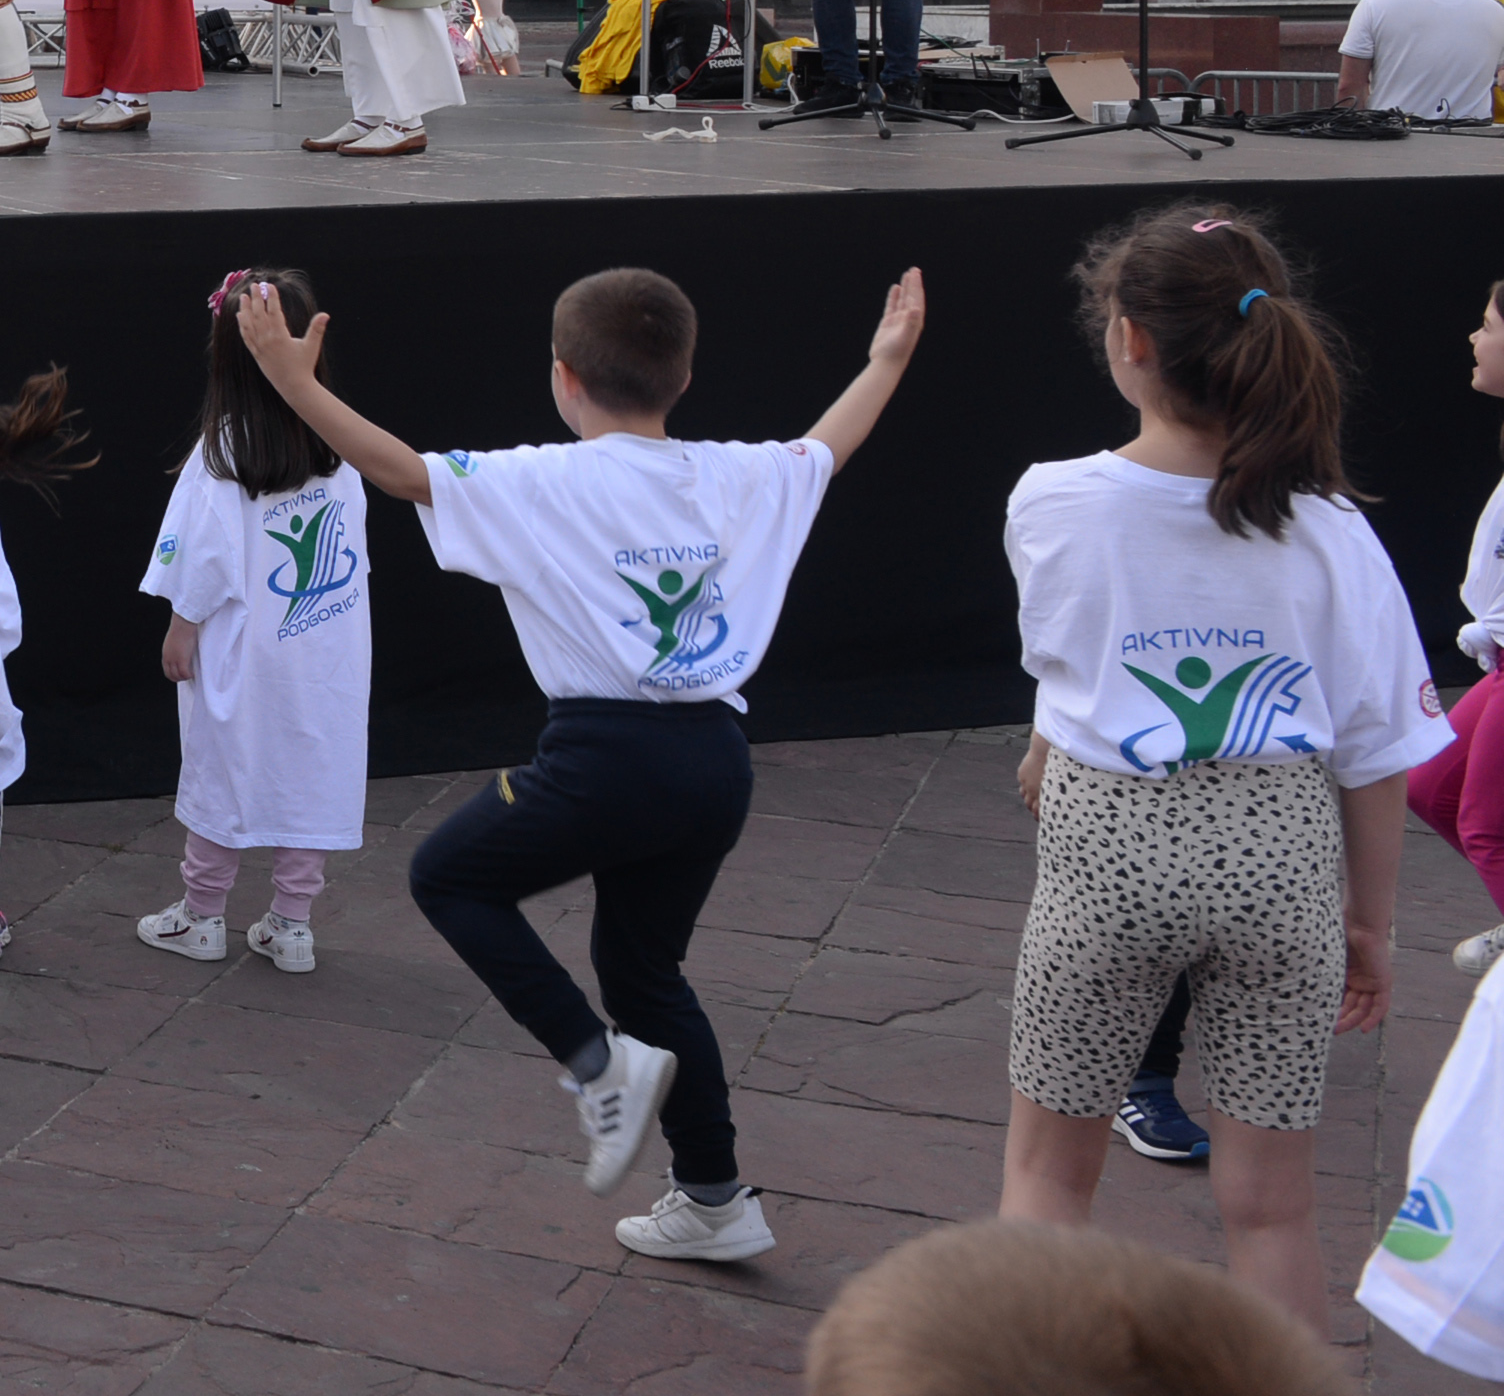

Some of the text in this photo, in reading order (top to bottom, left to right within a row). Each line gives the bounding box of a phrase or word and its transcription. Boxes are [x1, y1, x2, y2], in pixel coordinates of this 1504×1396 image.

[708, 57, 744, 69] Reebok
[263, 488, 327, 526] AKTIVNA
[614, 543, 720, 567] AKTIVNA
[277, 587, 361, 642] PODGORICA
[1121, 627, 1265, 655] AKTIVNA
